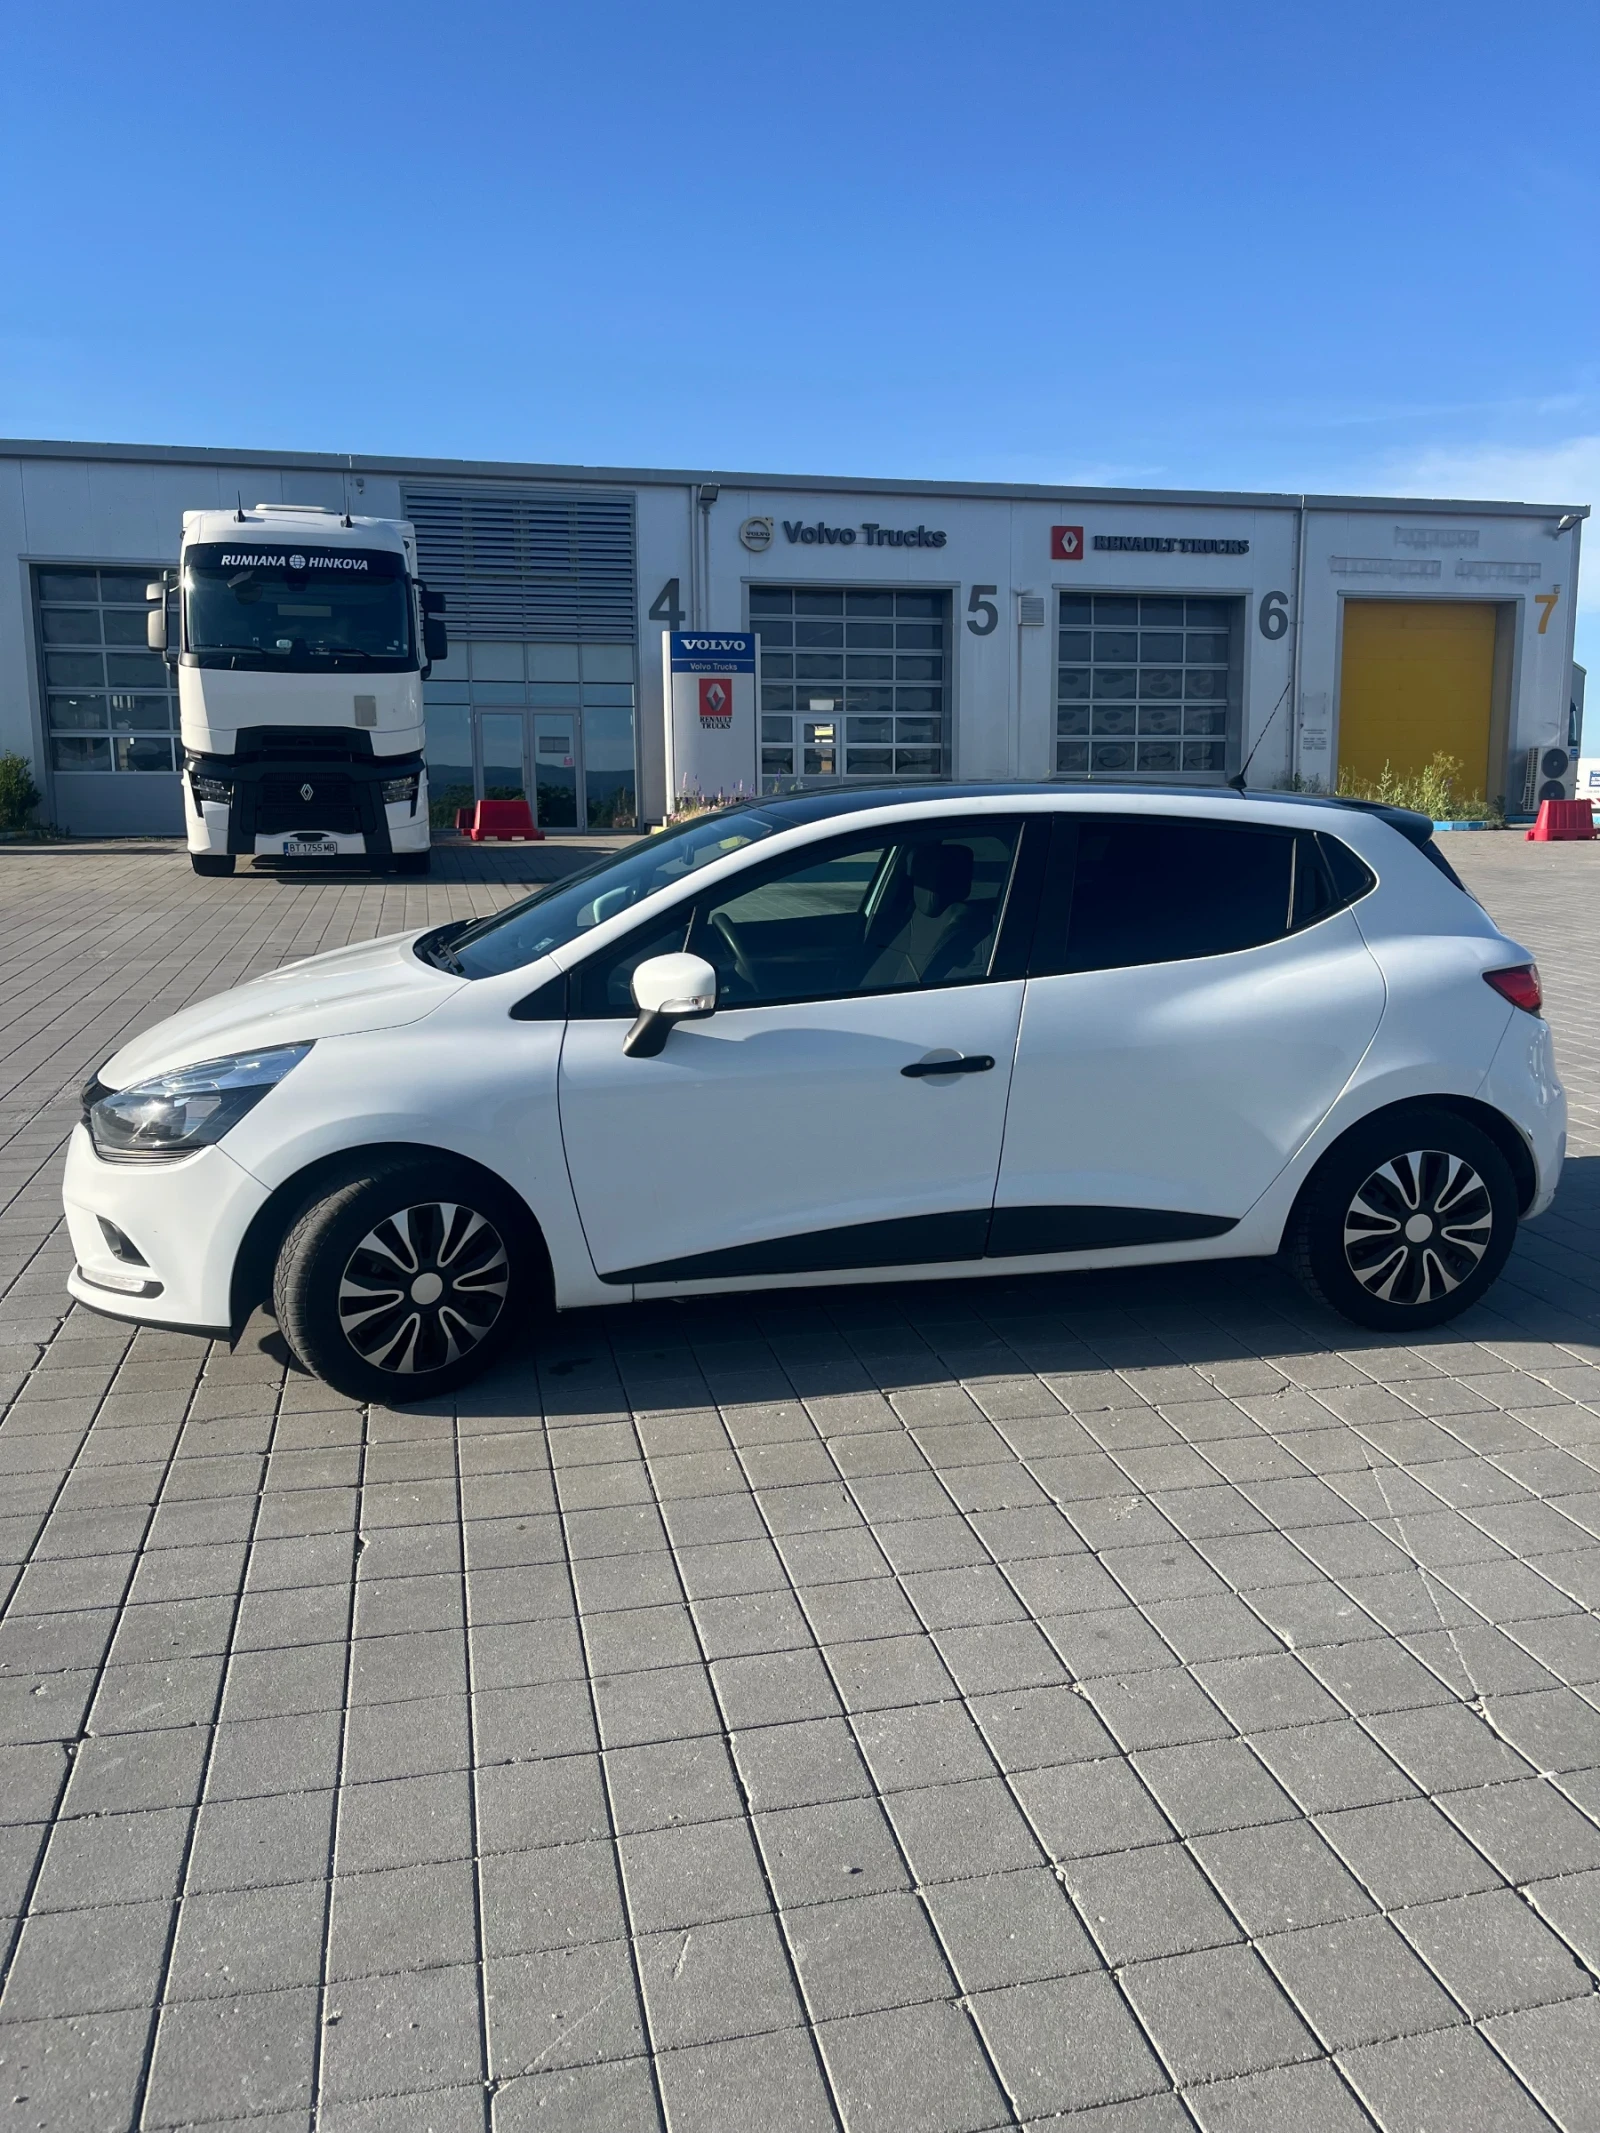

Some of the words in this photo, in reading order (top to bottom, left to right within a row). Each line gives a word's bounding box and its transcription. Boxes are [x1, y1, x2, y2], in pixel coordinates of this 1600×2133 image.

[783, 521, 856, 544] Volvo
[862, 523, 947, 547] Trucks
[1094, 536, 1177, 552] RENAULT
[1179, 538, 1249, 554] TRUCKS
[221, 555, 286, 566] RUMIANA
[309, 557, 368, 570] HINKOVA
[649, 578, 686, 631] 4
[967, 585, 998, 636] 5
[1259, 591, 1288, 640] 6
[1535, 595, 1558, 634] 7
[681, 639, 746, 651] VOLVO
[713, 663, 738, 671] Trucks
[303, 844, 322, 852] 1755
